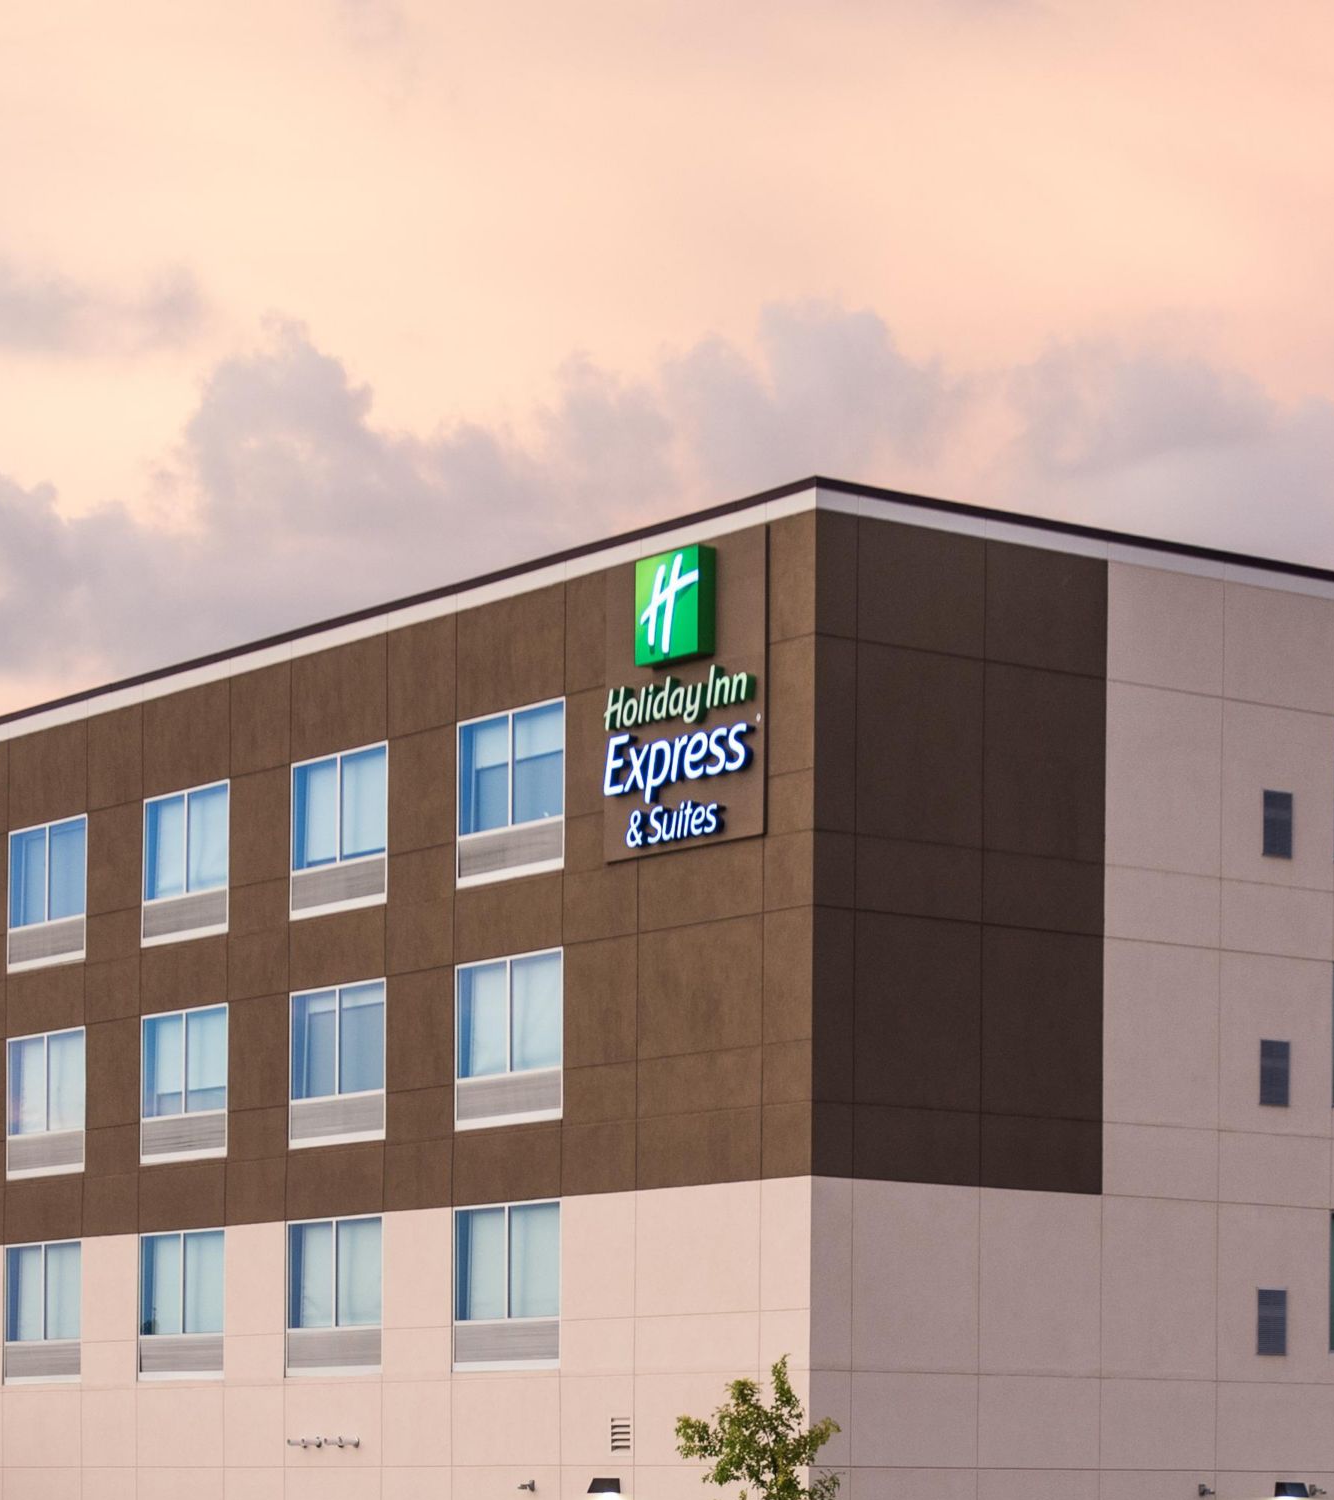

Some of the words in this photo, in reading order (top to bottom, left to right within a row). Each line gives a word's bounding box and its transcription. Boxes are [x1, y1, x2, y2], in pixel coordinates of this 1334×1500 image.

[604, 676, 703, 731] Holiday
[706, 665, 747, 708] Inn
[603, 722, 748, 803] Express
[625, 810, 643, 848] &
[647, 800, 717, 843] Suites
